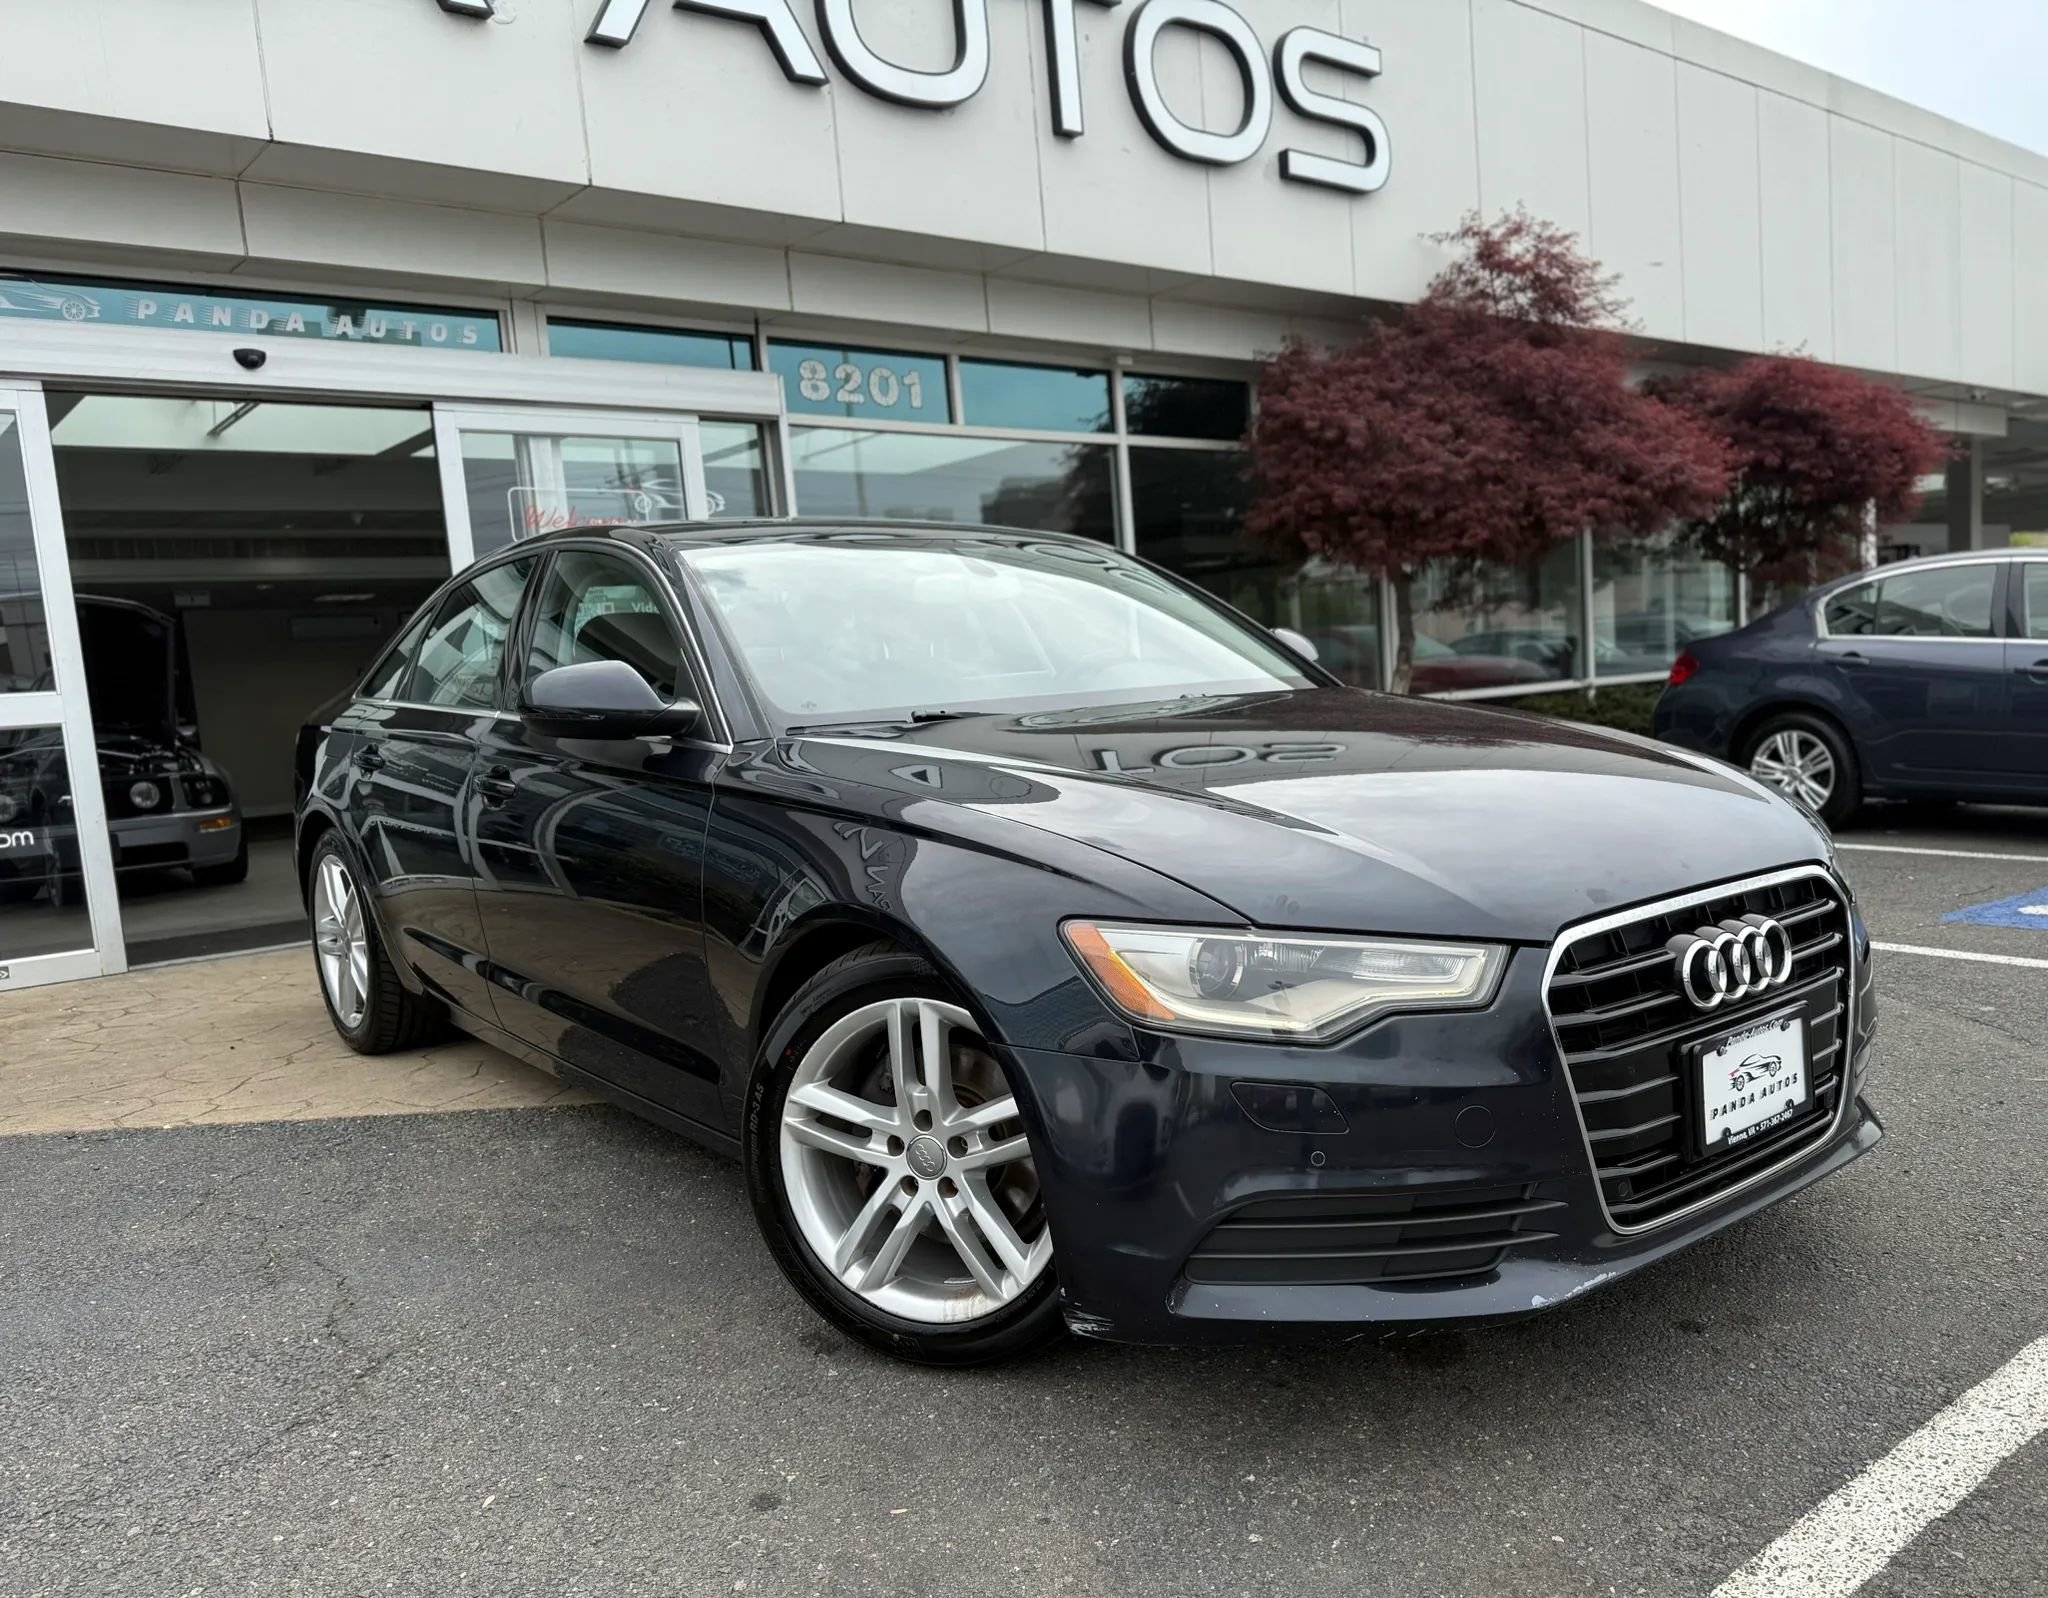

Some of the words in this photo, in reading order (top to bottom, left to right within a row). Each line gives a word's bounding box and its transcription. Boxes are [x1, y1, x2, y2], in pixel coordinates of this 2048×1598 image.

[137, 299, 306, 333] PANDA
[336, 314, 478, 346] AUTOS
[799, 359, 923, 408] 8201
[1711, 1092, 1755, 1120] PANDA
[1760, 1073, 1798, 1100] AUTOS
